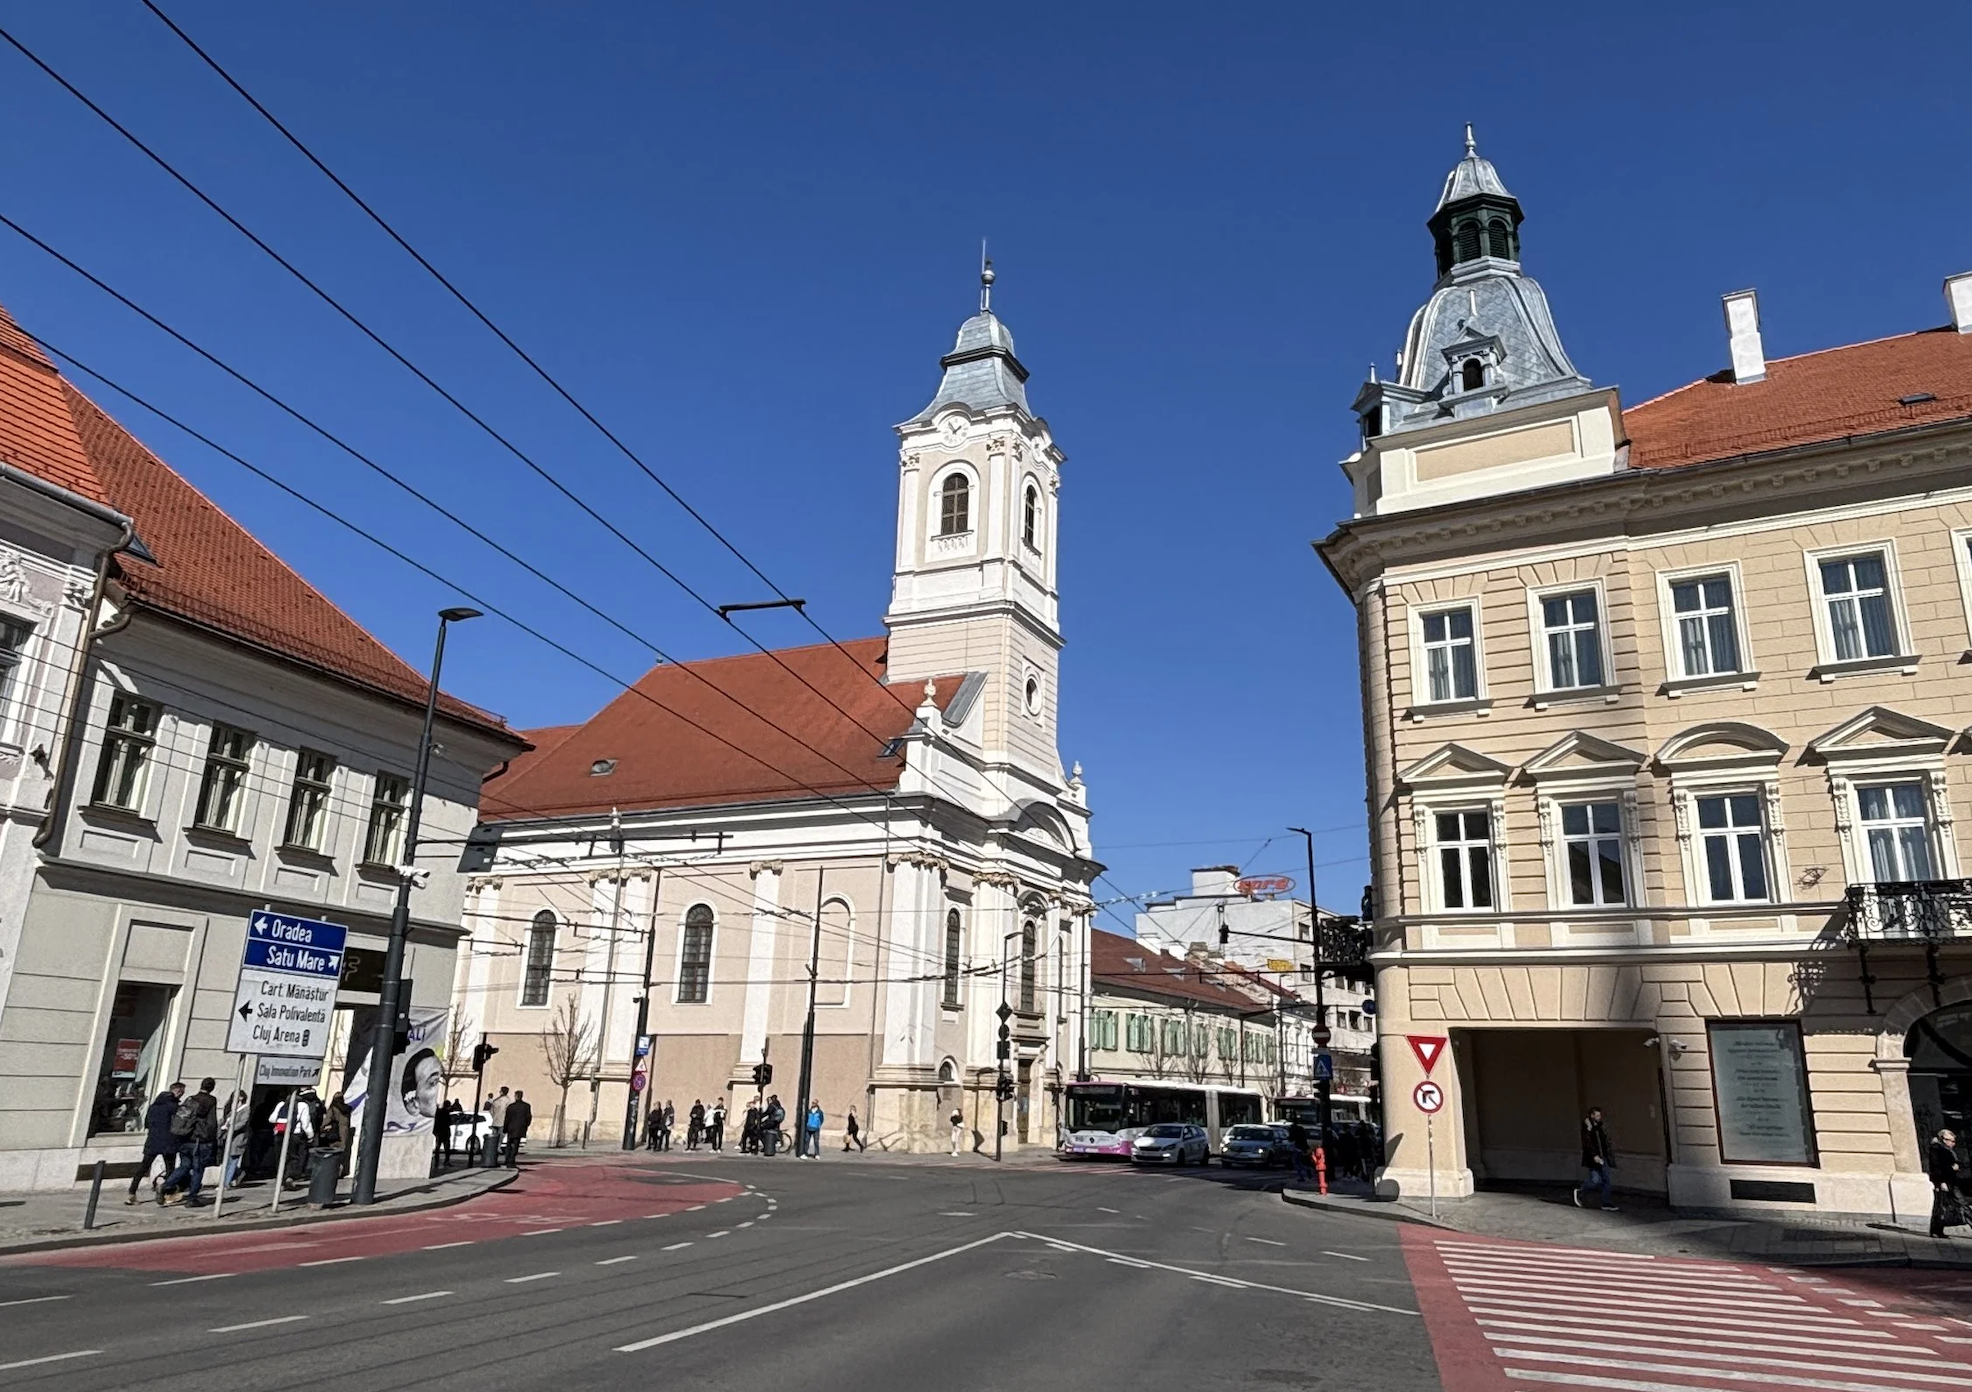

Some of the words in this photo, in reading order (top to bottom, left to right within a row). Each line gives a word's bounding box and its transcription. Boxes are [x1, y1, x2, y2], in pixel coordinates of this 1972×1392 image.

[271, 918, 313, 943] Oradea
[266, 945, 295, 967] Satu
[295, 949, 326, 972] Mare
[257, 1002, 277, 1019] Sala
[252, 1024, 272, 1045] Cluj
[272, 1026, 300, 1043] Arena
